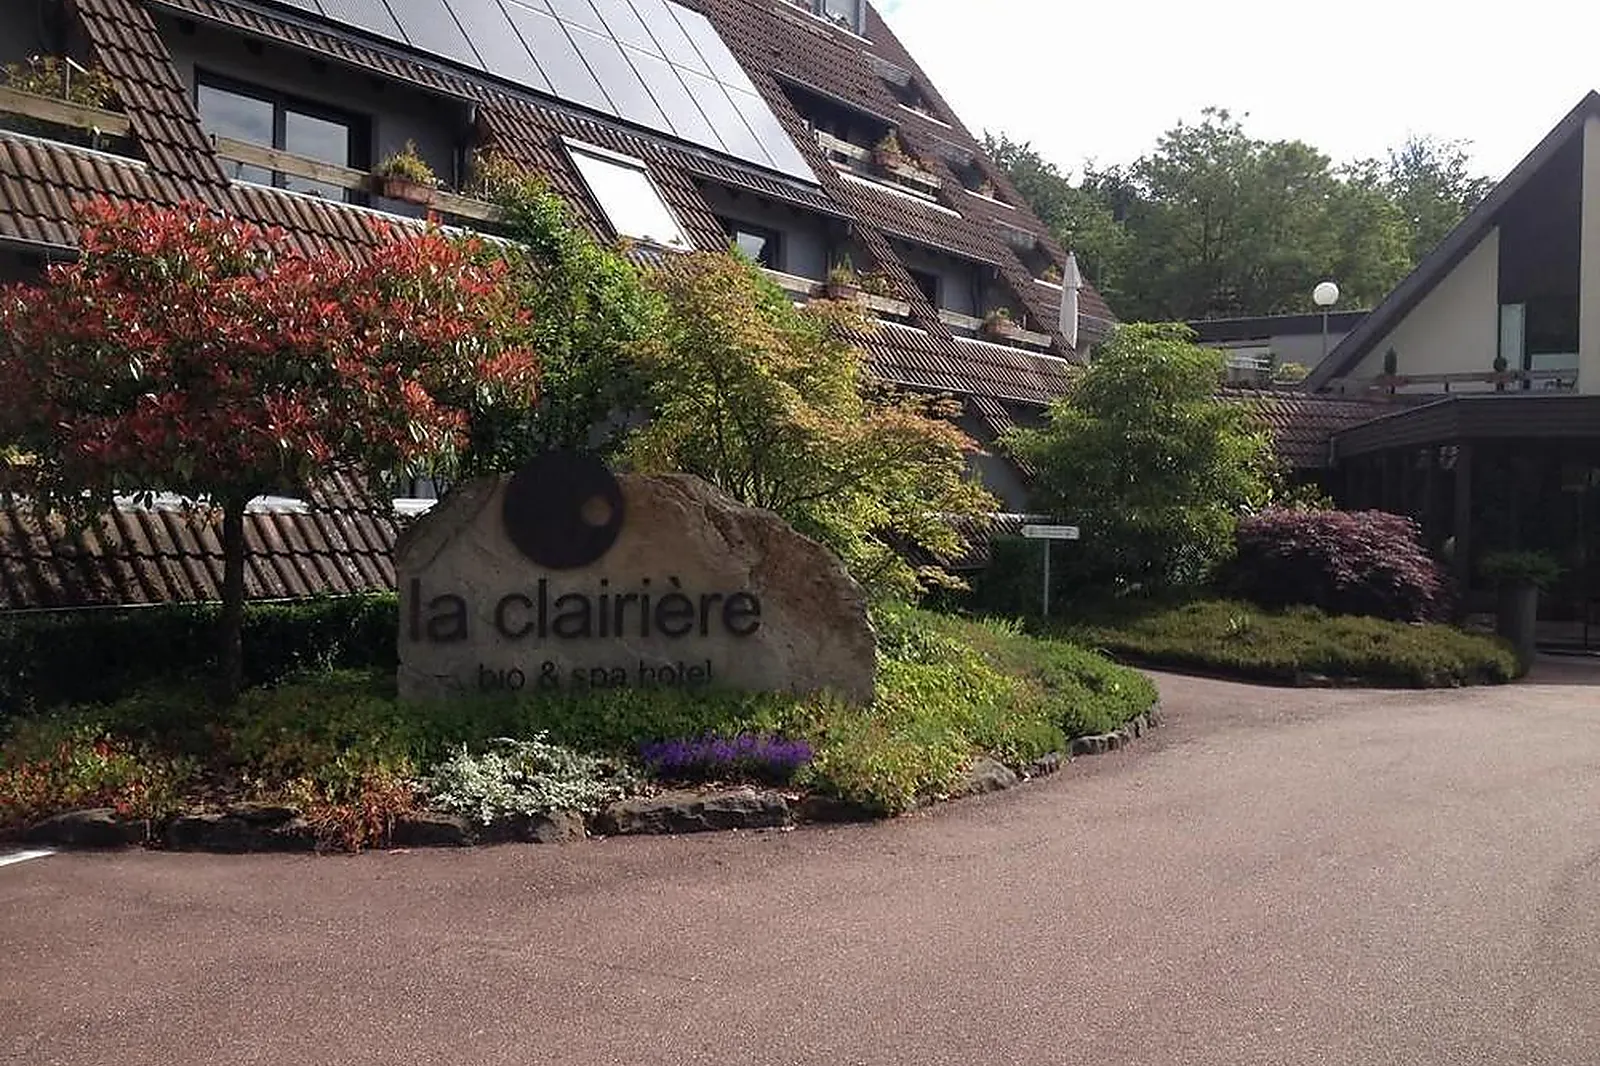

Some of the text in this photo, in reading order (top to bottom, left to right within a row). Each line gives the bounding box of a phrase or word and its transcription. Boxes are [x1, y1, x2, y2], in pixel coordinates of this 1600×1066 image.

[409, 576, 762, 642] la clairière
[478, 659, 713, 690] bio & spa hotel
